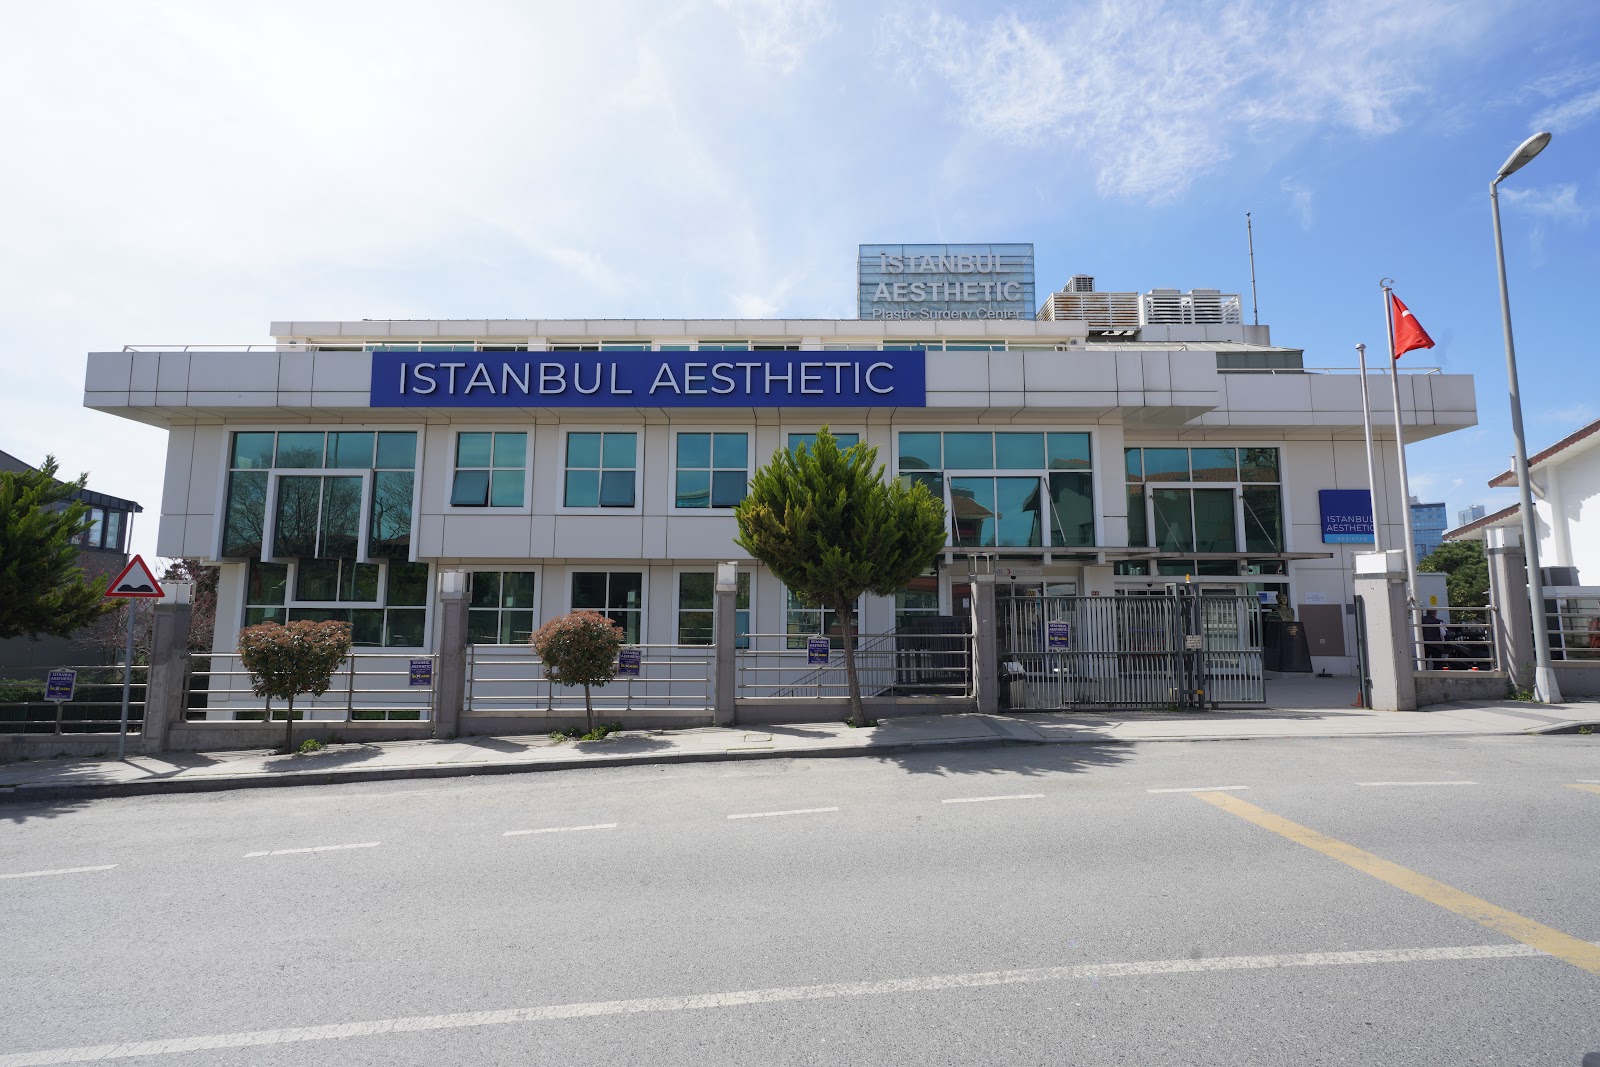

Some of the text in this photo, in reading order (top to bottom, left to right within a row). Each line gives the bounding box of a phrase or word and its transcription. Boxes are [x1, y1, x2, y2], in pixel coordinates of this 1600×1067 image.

[873, 282, 1021, 302] AESTHETIC
[872, 308, 1021, 320] Plastic Surgery Center
[399, 361, 895, 395] ISTANBUL AESTHETIC
[1326, 515, 1374, 523] ISTANBUL
